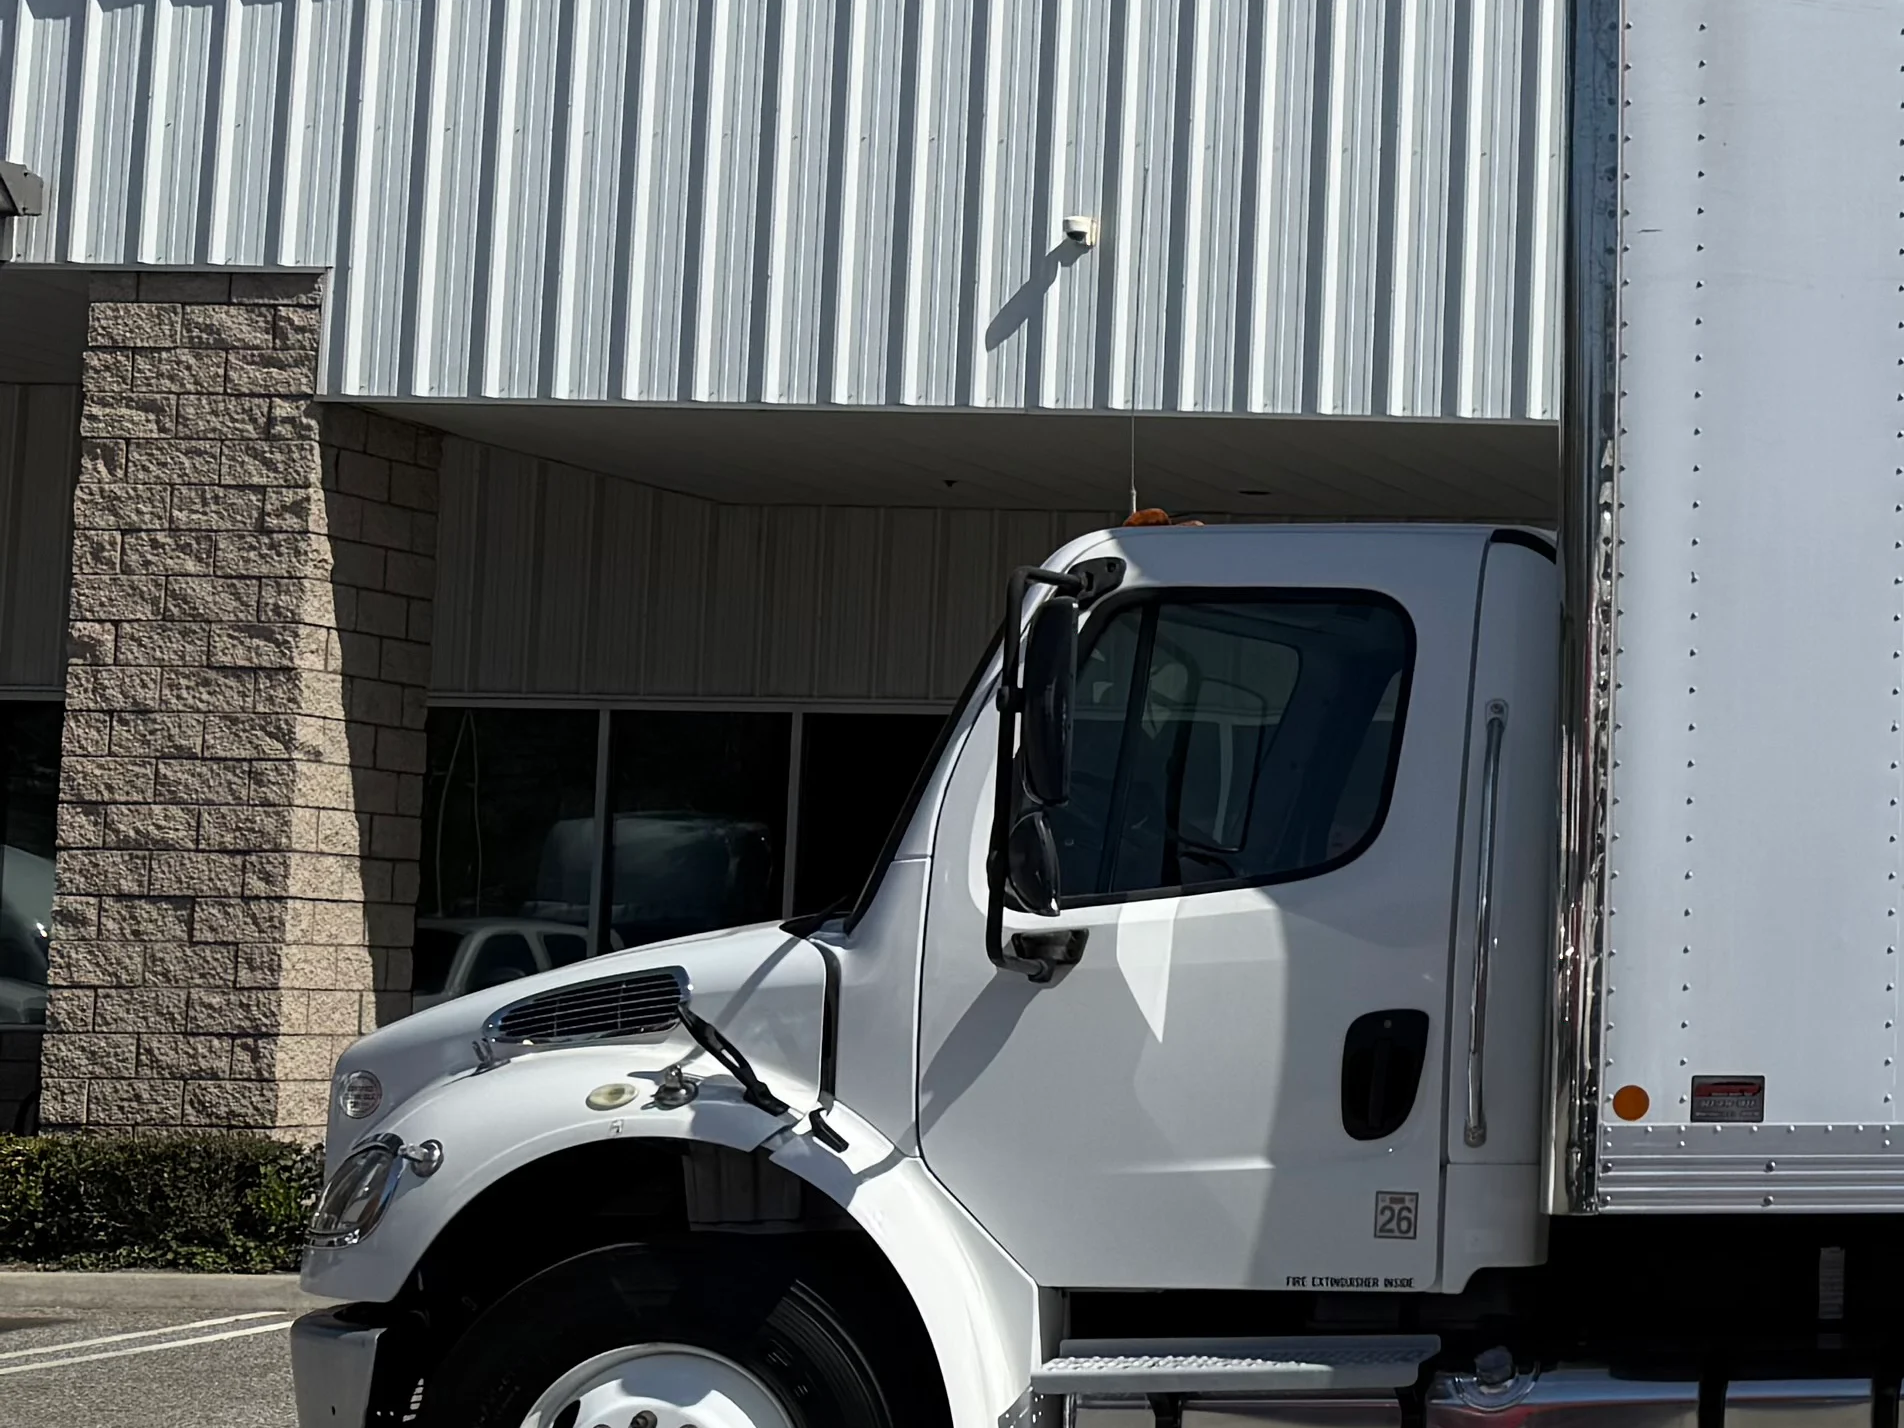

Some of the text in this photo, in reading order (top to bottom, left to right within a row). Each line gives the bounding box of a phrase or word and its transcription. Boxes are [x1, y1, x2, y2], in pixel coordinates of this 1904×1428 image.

[1379, 1205, 1412, 1234] 26
[1286, 1276, 1307, 1287] FIRE
[1384, 1278, 1414, 1288] INSIDE
